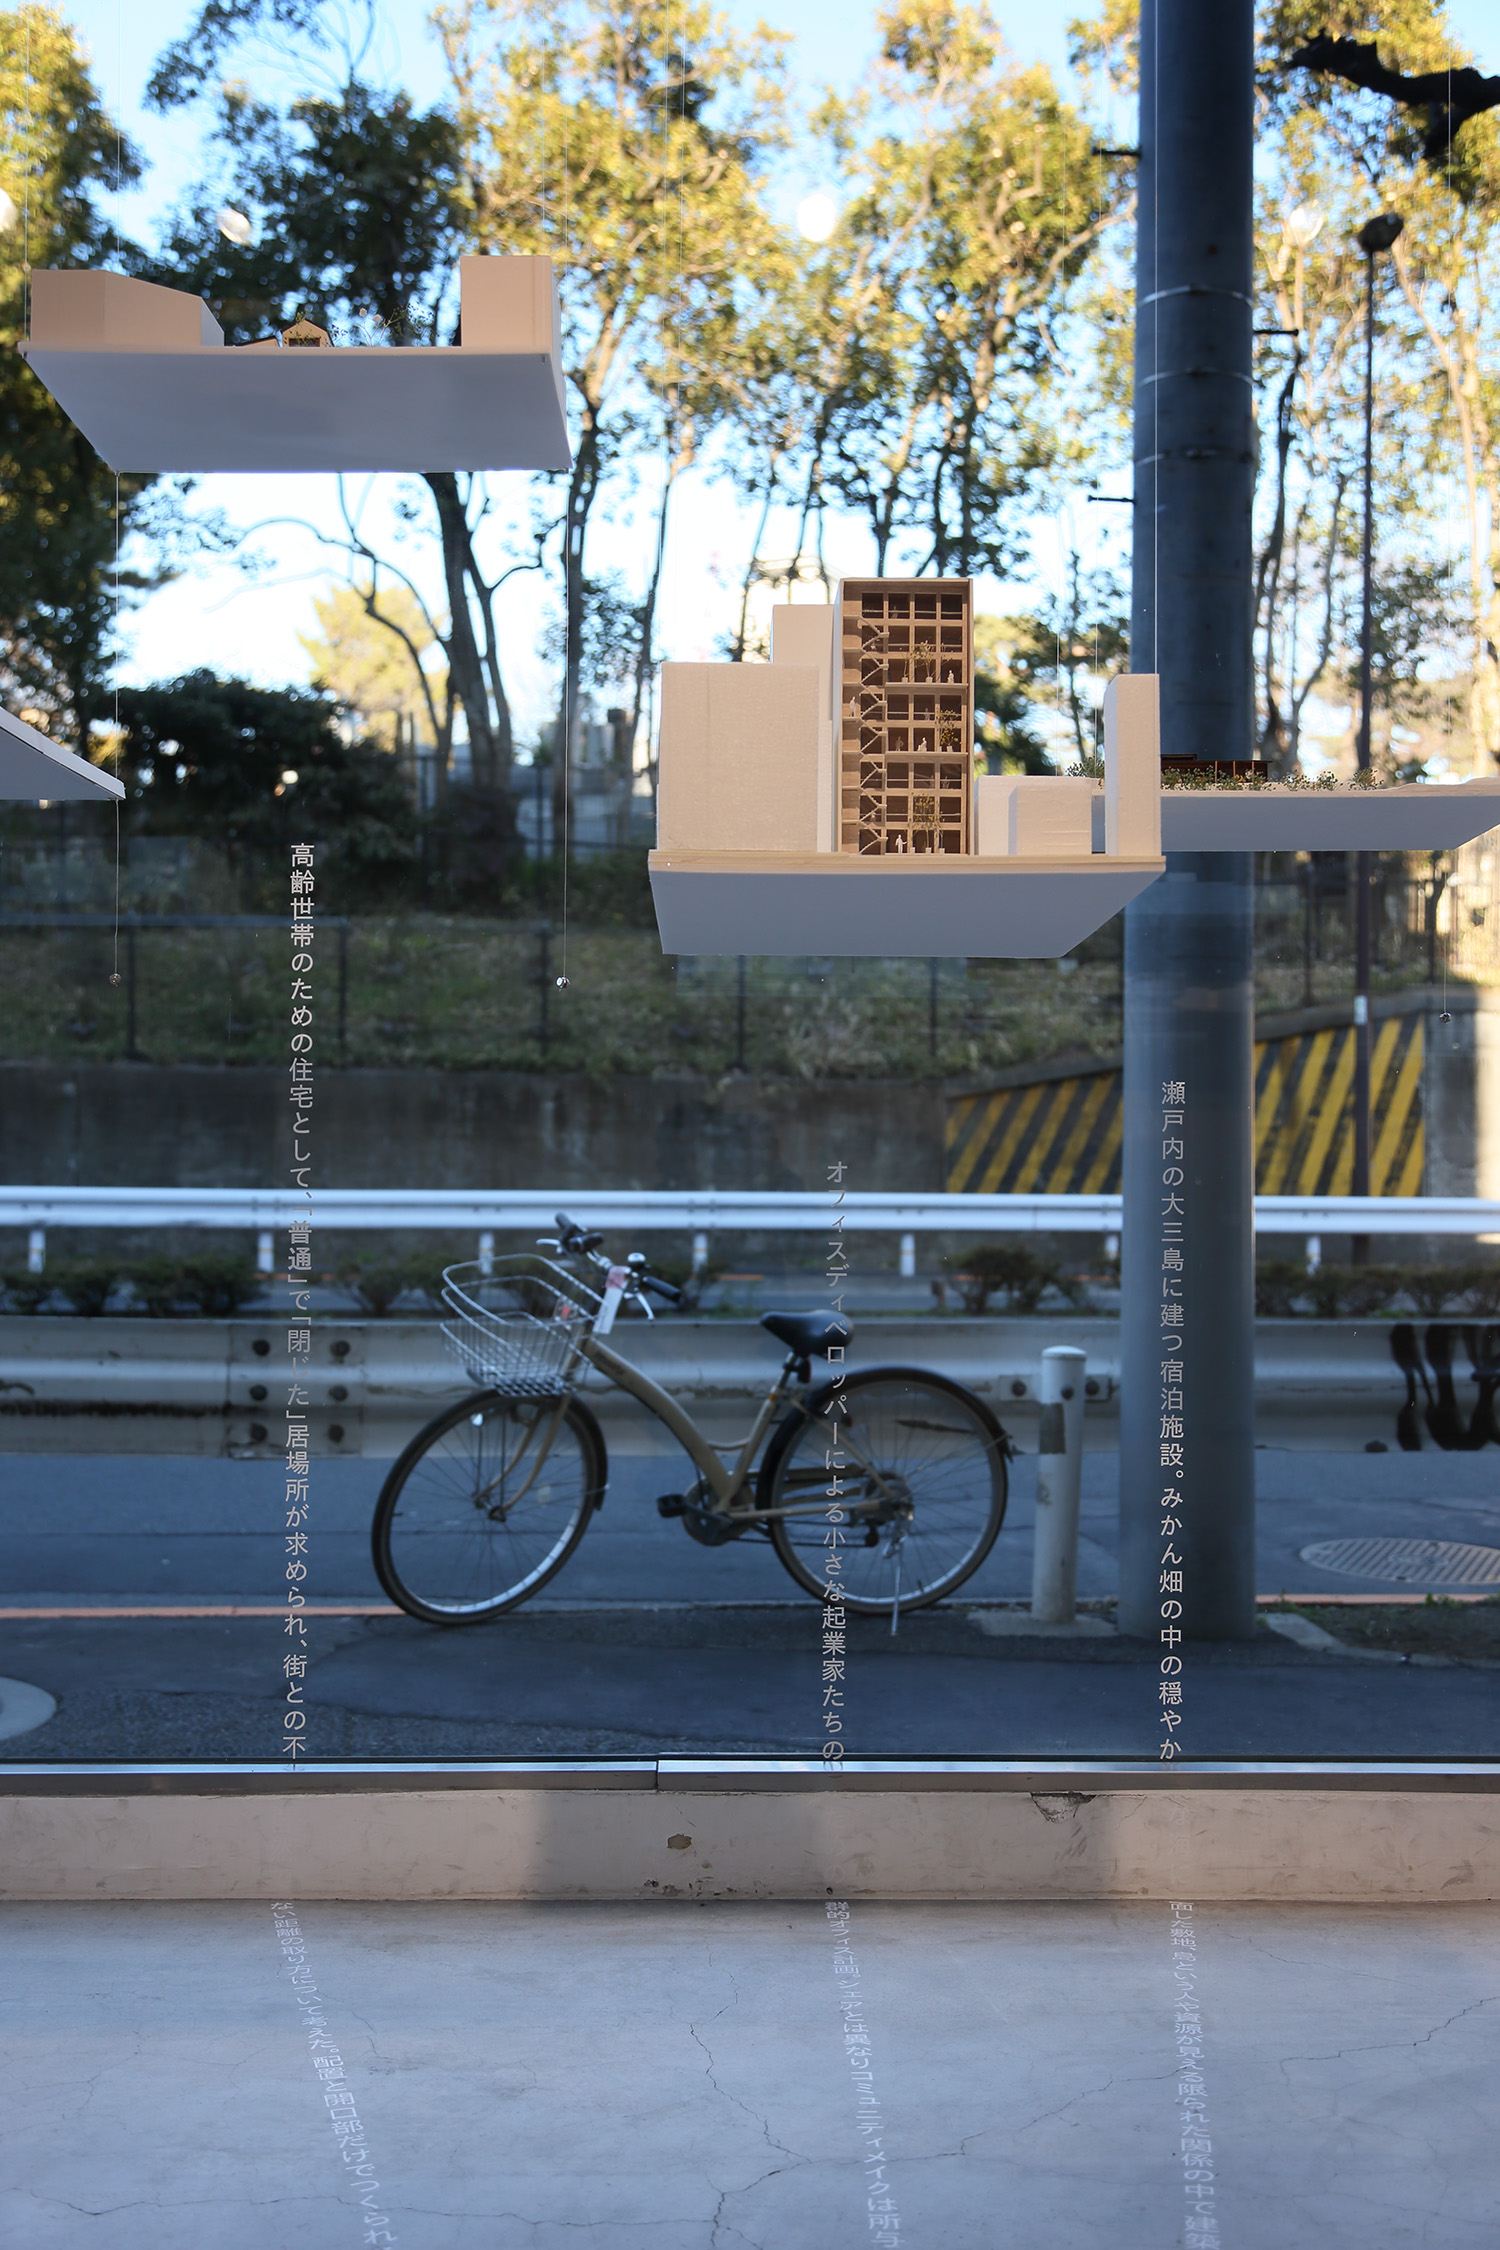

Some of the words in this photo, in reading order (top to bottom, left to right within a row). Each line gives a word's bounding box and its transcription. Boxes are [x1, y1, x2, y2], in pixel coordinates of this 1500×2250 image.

[822, 1161, 850, 1760] オフィスディベロッパーによる小さな起業家たちの
[1159, 1081, 1186, 1760] 瀬戸内の大三島に建つ宿泊施設。みかん畑の中の穏やか
[270, 1902, 398, 2250] ない距離の取り方について考えた。配置と開口部だけでつくられ
